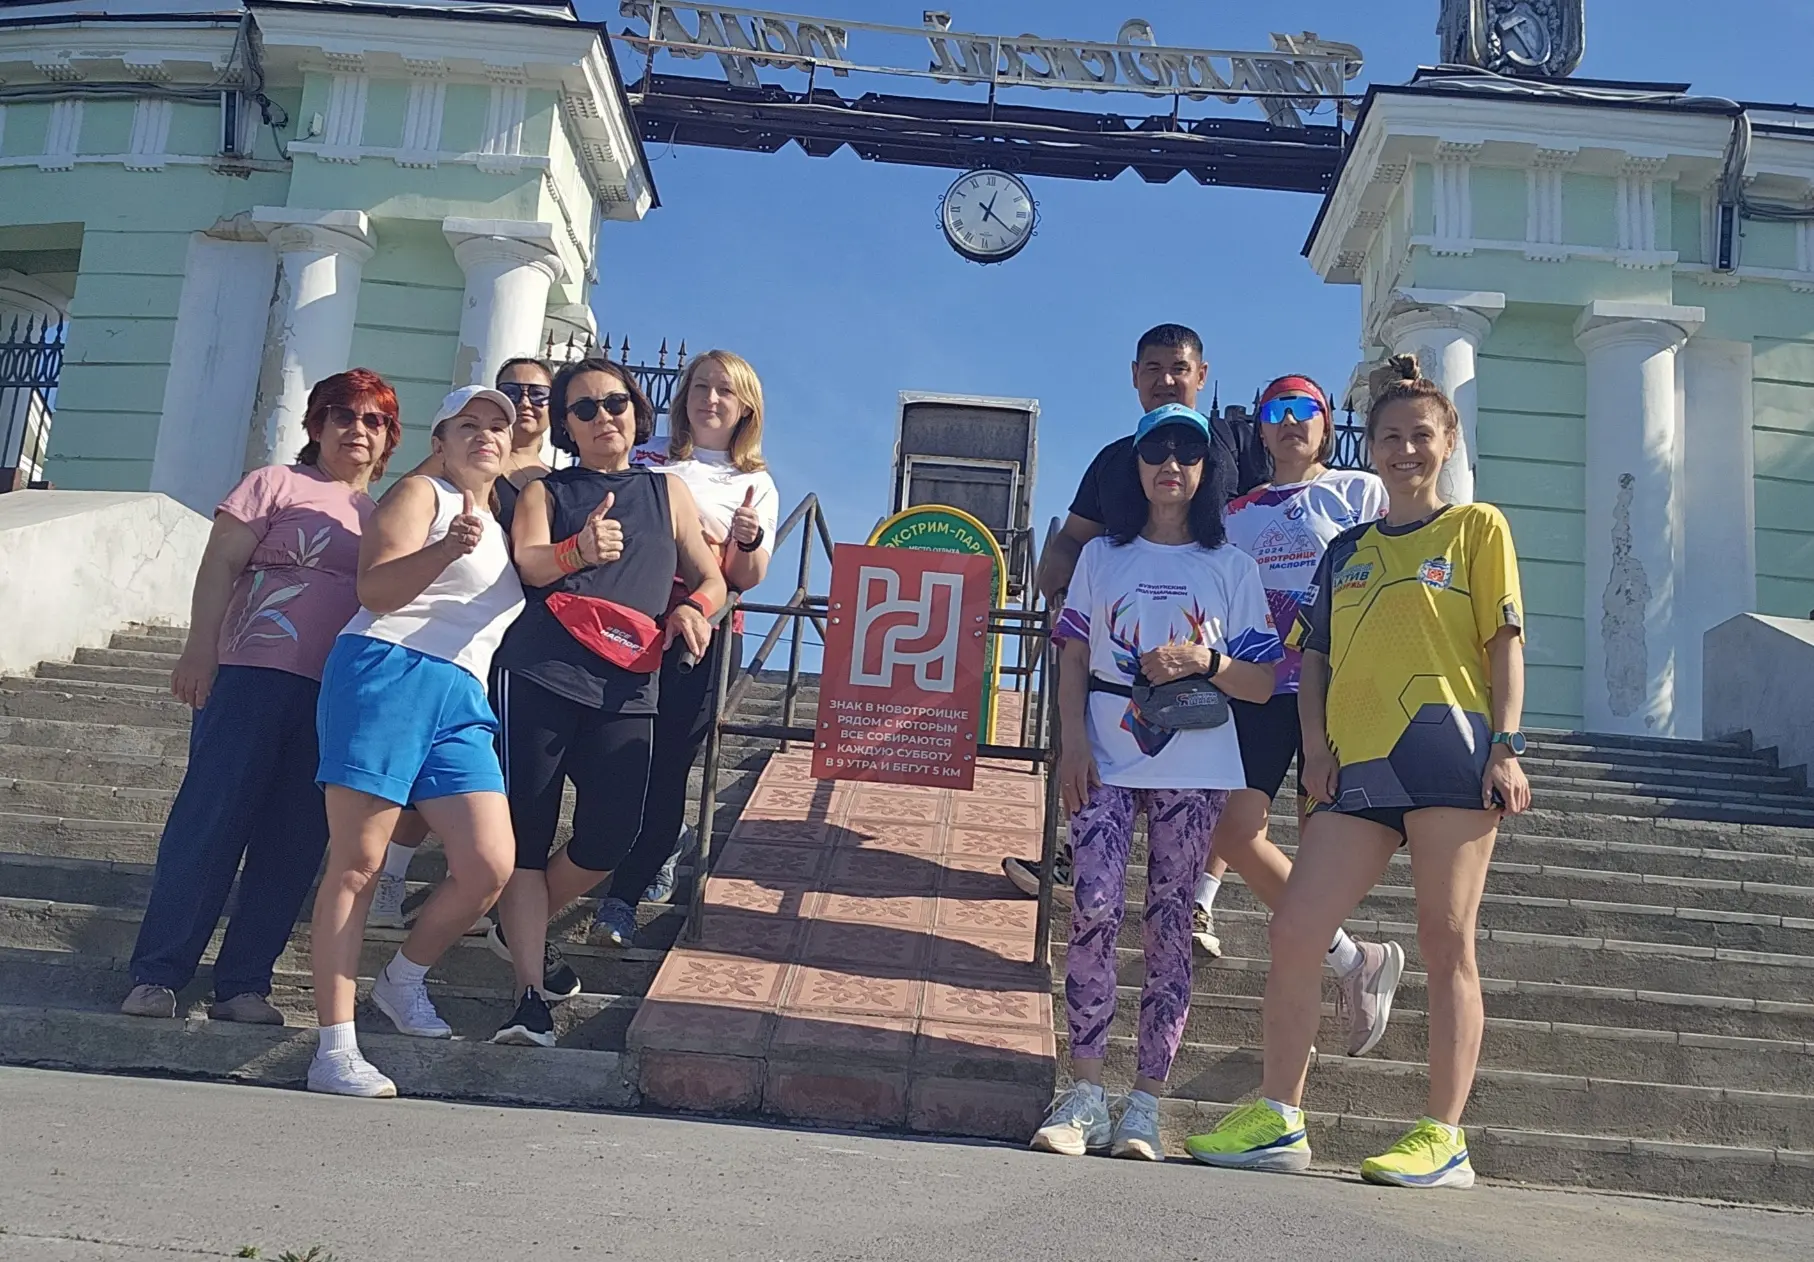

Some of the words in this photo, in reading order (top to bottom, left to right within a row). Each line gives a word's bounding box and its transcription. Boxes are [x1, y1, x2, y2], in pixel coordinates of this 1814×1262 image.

[1256, 552, 1316, 564] ОВОТРОИЦК
[1258, 546, 1284, 556] 2024
[600, 629, 649, 655] НАСПОРТ
[829, 700, 862, 710] ЗНАК
[866, 702, 874, 712] В
[876, 703, 968, 720] НОВОТРОИЦКЕ
[838, 714, 881, 727] РЯДОМ
[884, 718, 892, 728] С
[896, 720, 958, 734] КОТОРЫМ
[840, 730, 864, 740] ВСЕ
[866, 732, 952, 748] СОБИРАЮТСЯ
[837, 744, 894, 757] КАЖДУЮ
[896, 748, 952, 762] СУББОТУ
[826, 758, 834, 766] В
[836, 758, 844, 767] 9
[847, 760, 878, 770] УТРА
[880, 761, 890, 770] И
[892, 763, 930, 774] БЕГУТ
[932, 766, 940, 775] 5
[942, 767, 960, 778] КМ
